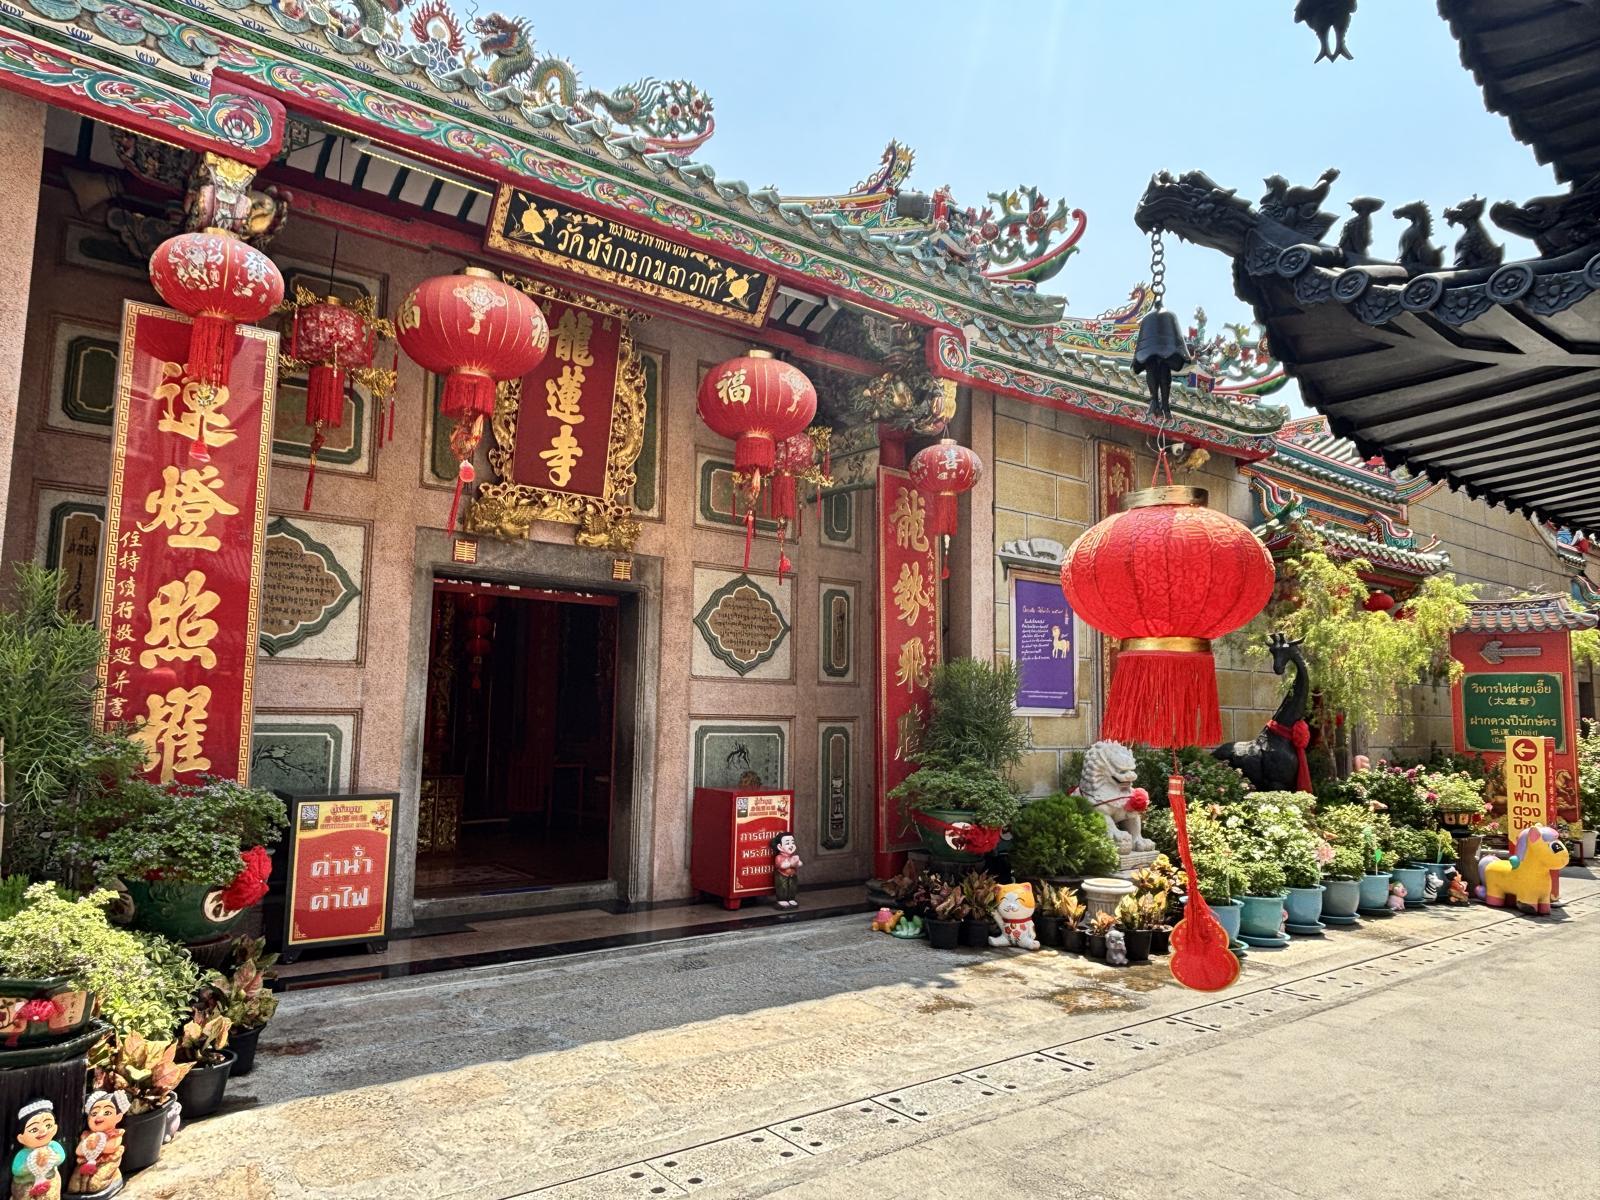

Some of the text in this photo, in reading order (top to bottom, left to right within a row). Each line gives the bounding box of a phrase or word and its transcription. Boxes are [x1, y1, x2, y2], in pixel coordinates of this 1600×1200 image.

[556, 224, 720, 297] วัดมังกรกมลาวาศ
[715, 368, 752, 405] 福
[538, 308, 595, 487] 龍蓮寺
[1470, 714, 1557, 726] ฝากดวงปีนักษัตร
[1514, 764, 1537, 775] ทาง
[1518, 775, 1533, 788] ไป
[1514, 789, 1539, 803] ฝาก
[1513, 806, 1541, 817] ดวง
[311, 845, 373, 877] ค่าน้ำ
[310, 886, 370, 912] ค่าไฟ
